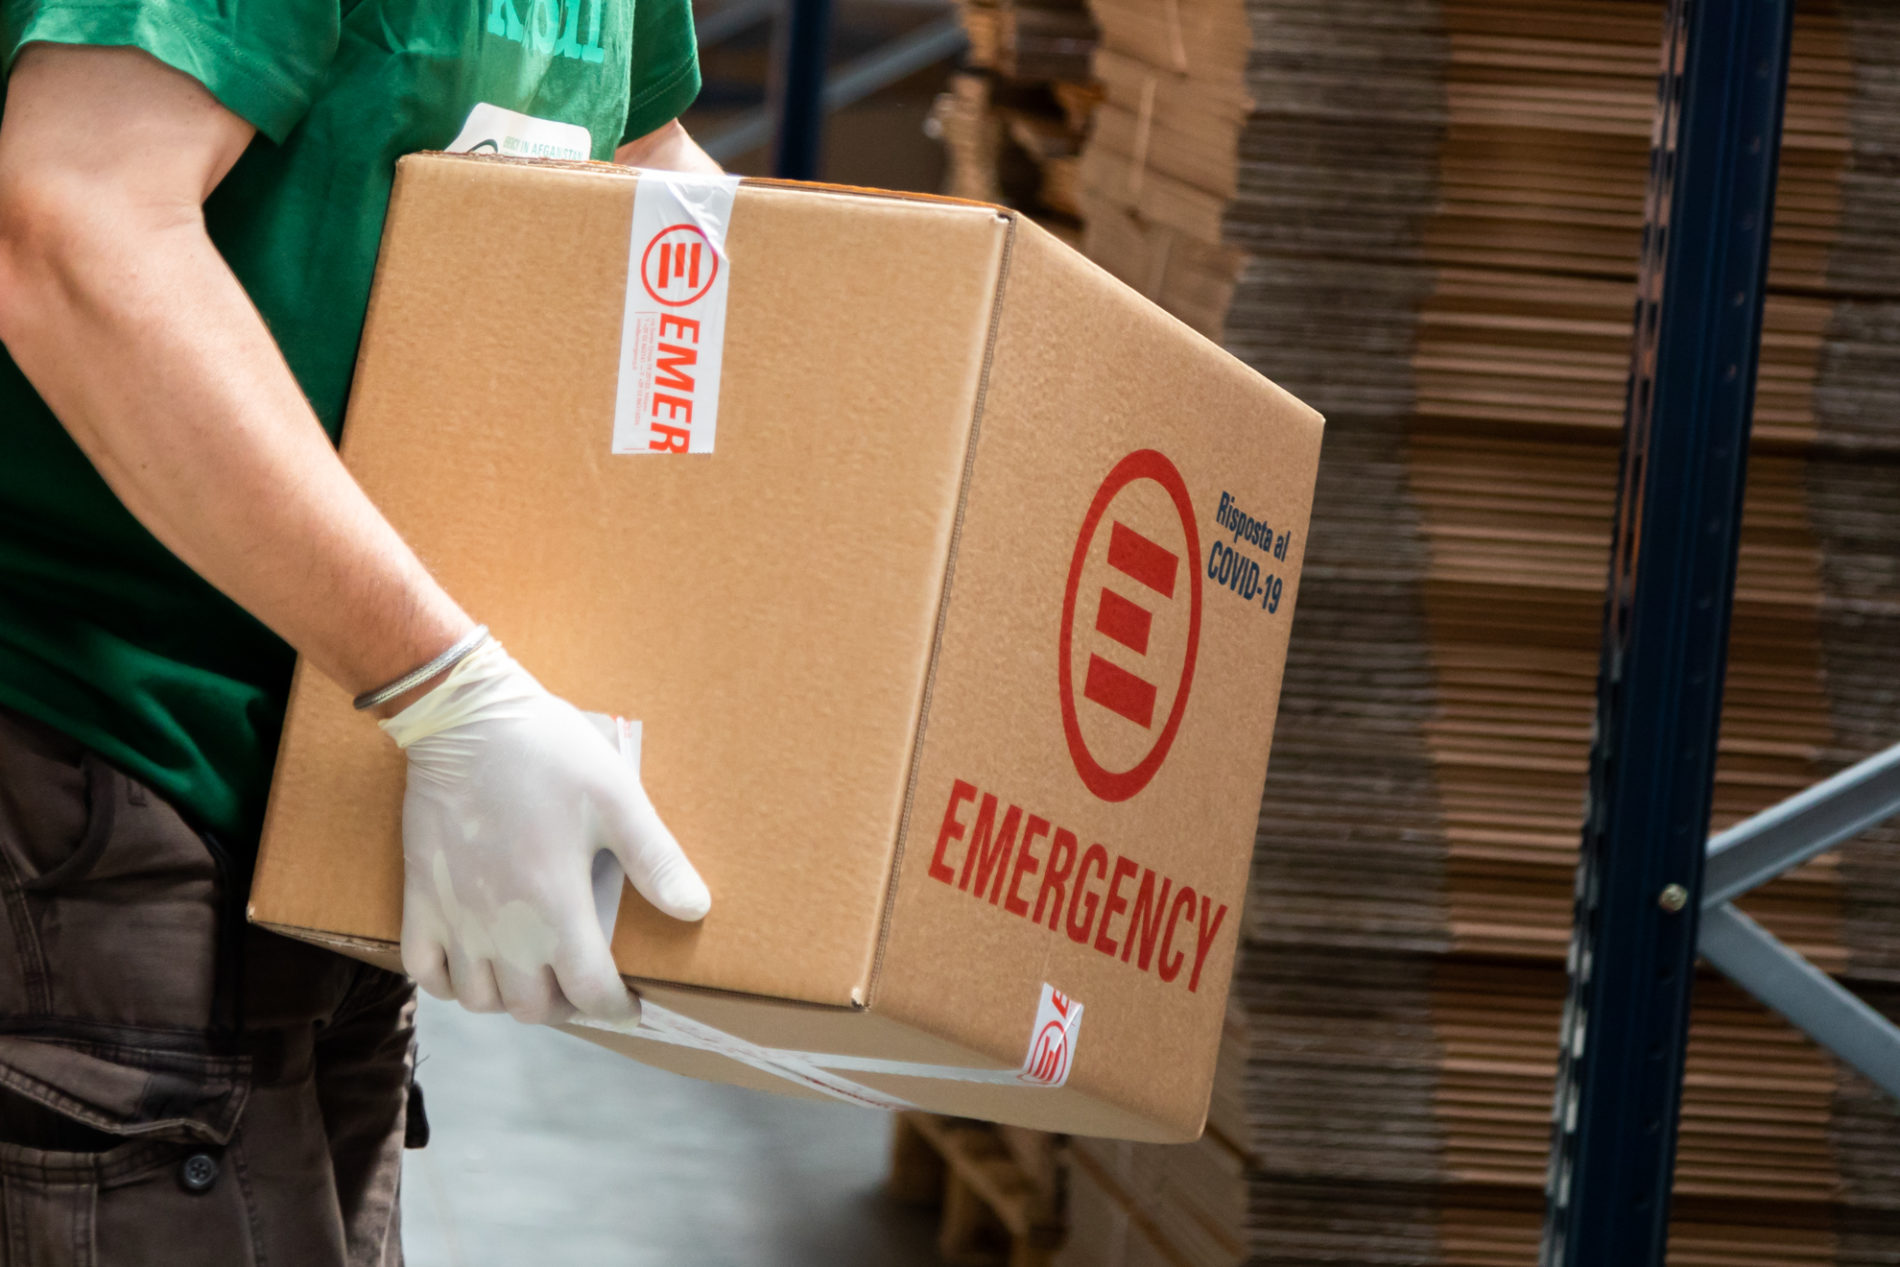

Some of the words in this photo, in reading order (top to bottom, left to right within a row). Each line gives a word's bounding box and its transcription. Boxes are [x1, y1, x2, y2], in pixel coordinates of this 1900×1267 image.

[649, 312, 700, 454] EMER
[1207, 540, 1283, 614] COVID-19
[1216, 490, 1273, 552] Risposta
[1273, 530, 1291, 562] al
[928, 778, 1228, 993] EMERGENCY
